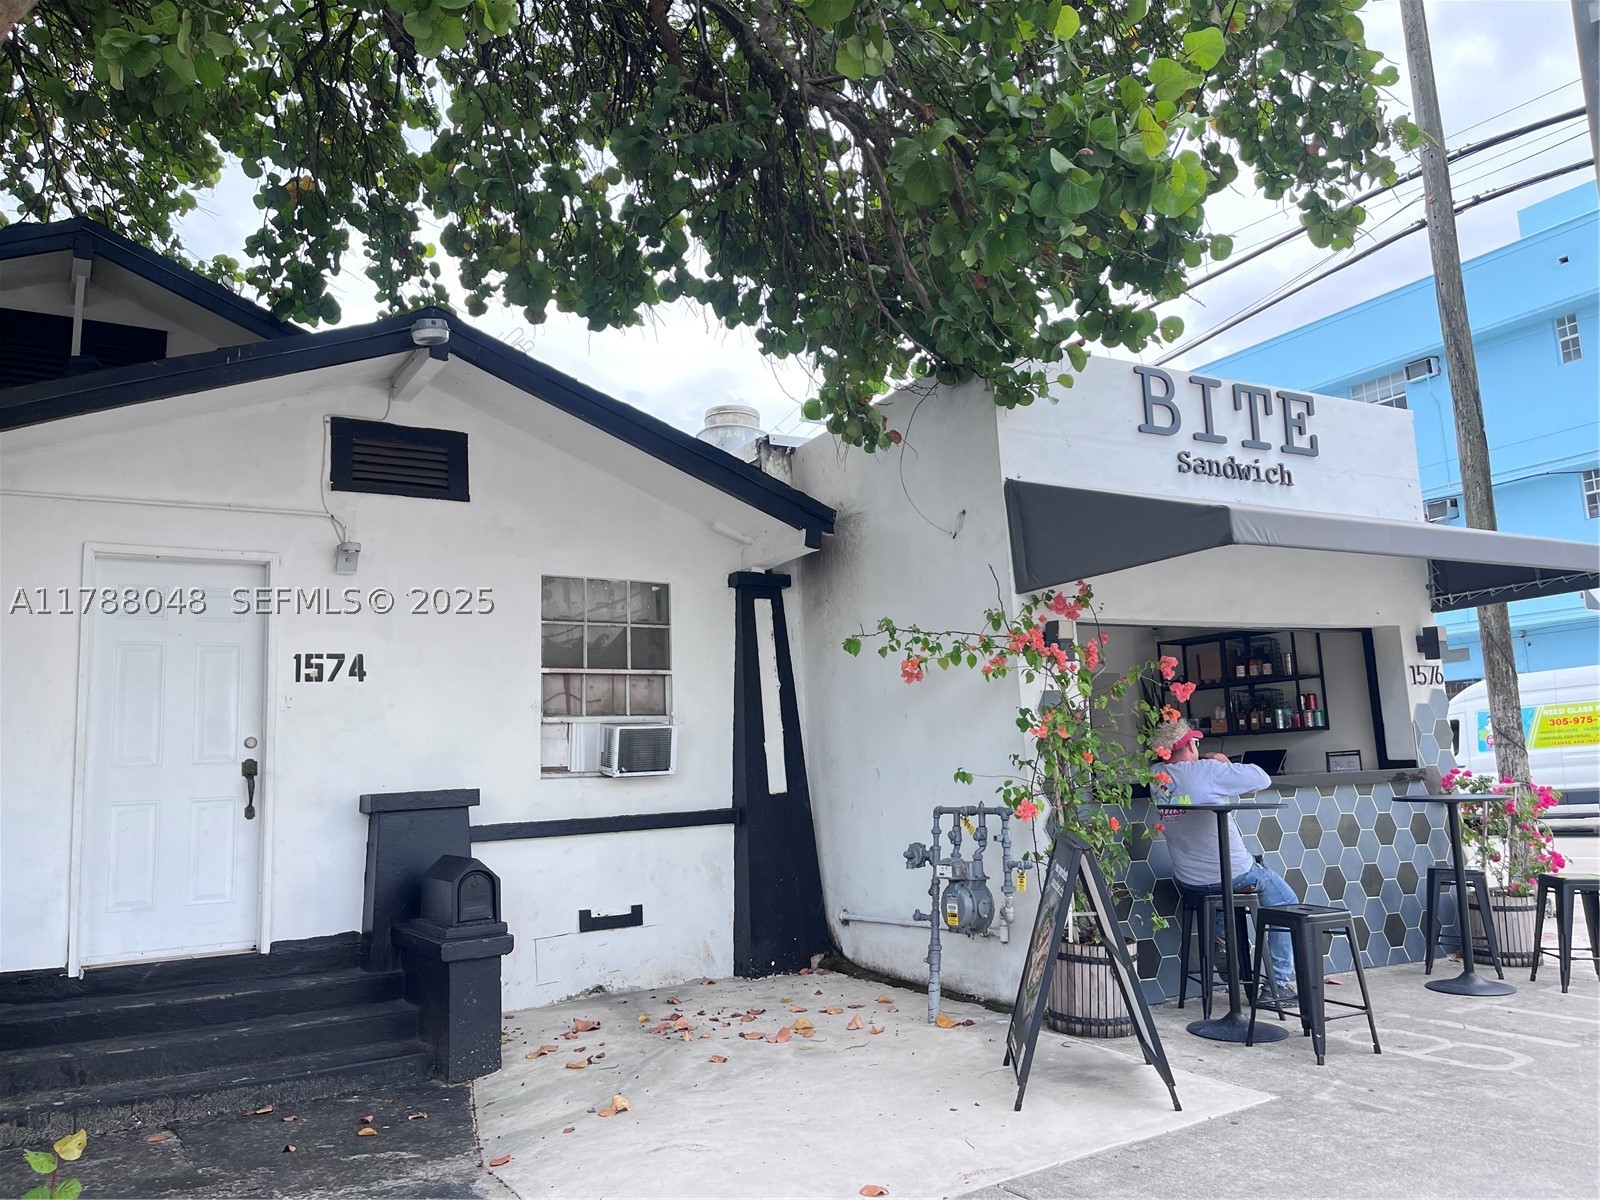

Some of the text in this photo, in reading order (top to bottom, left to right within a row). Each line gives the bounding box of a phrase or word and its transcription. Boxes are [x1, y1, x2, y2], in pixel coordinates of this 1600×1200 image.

[1133, 365, 1319, 457] BITE
[1177, 451, 1294, 486] Sandwich
[294, 653, 367, 682] 1574
[1410, 665, 1444, 685] 1576
[1549, 715, 1600, 726] 305-975-
[1566, 705, 1593, 714] GLASS
